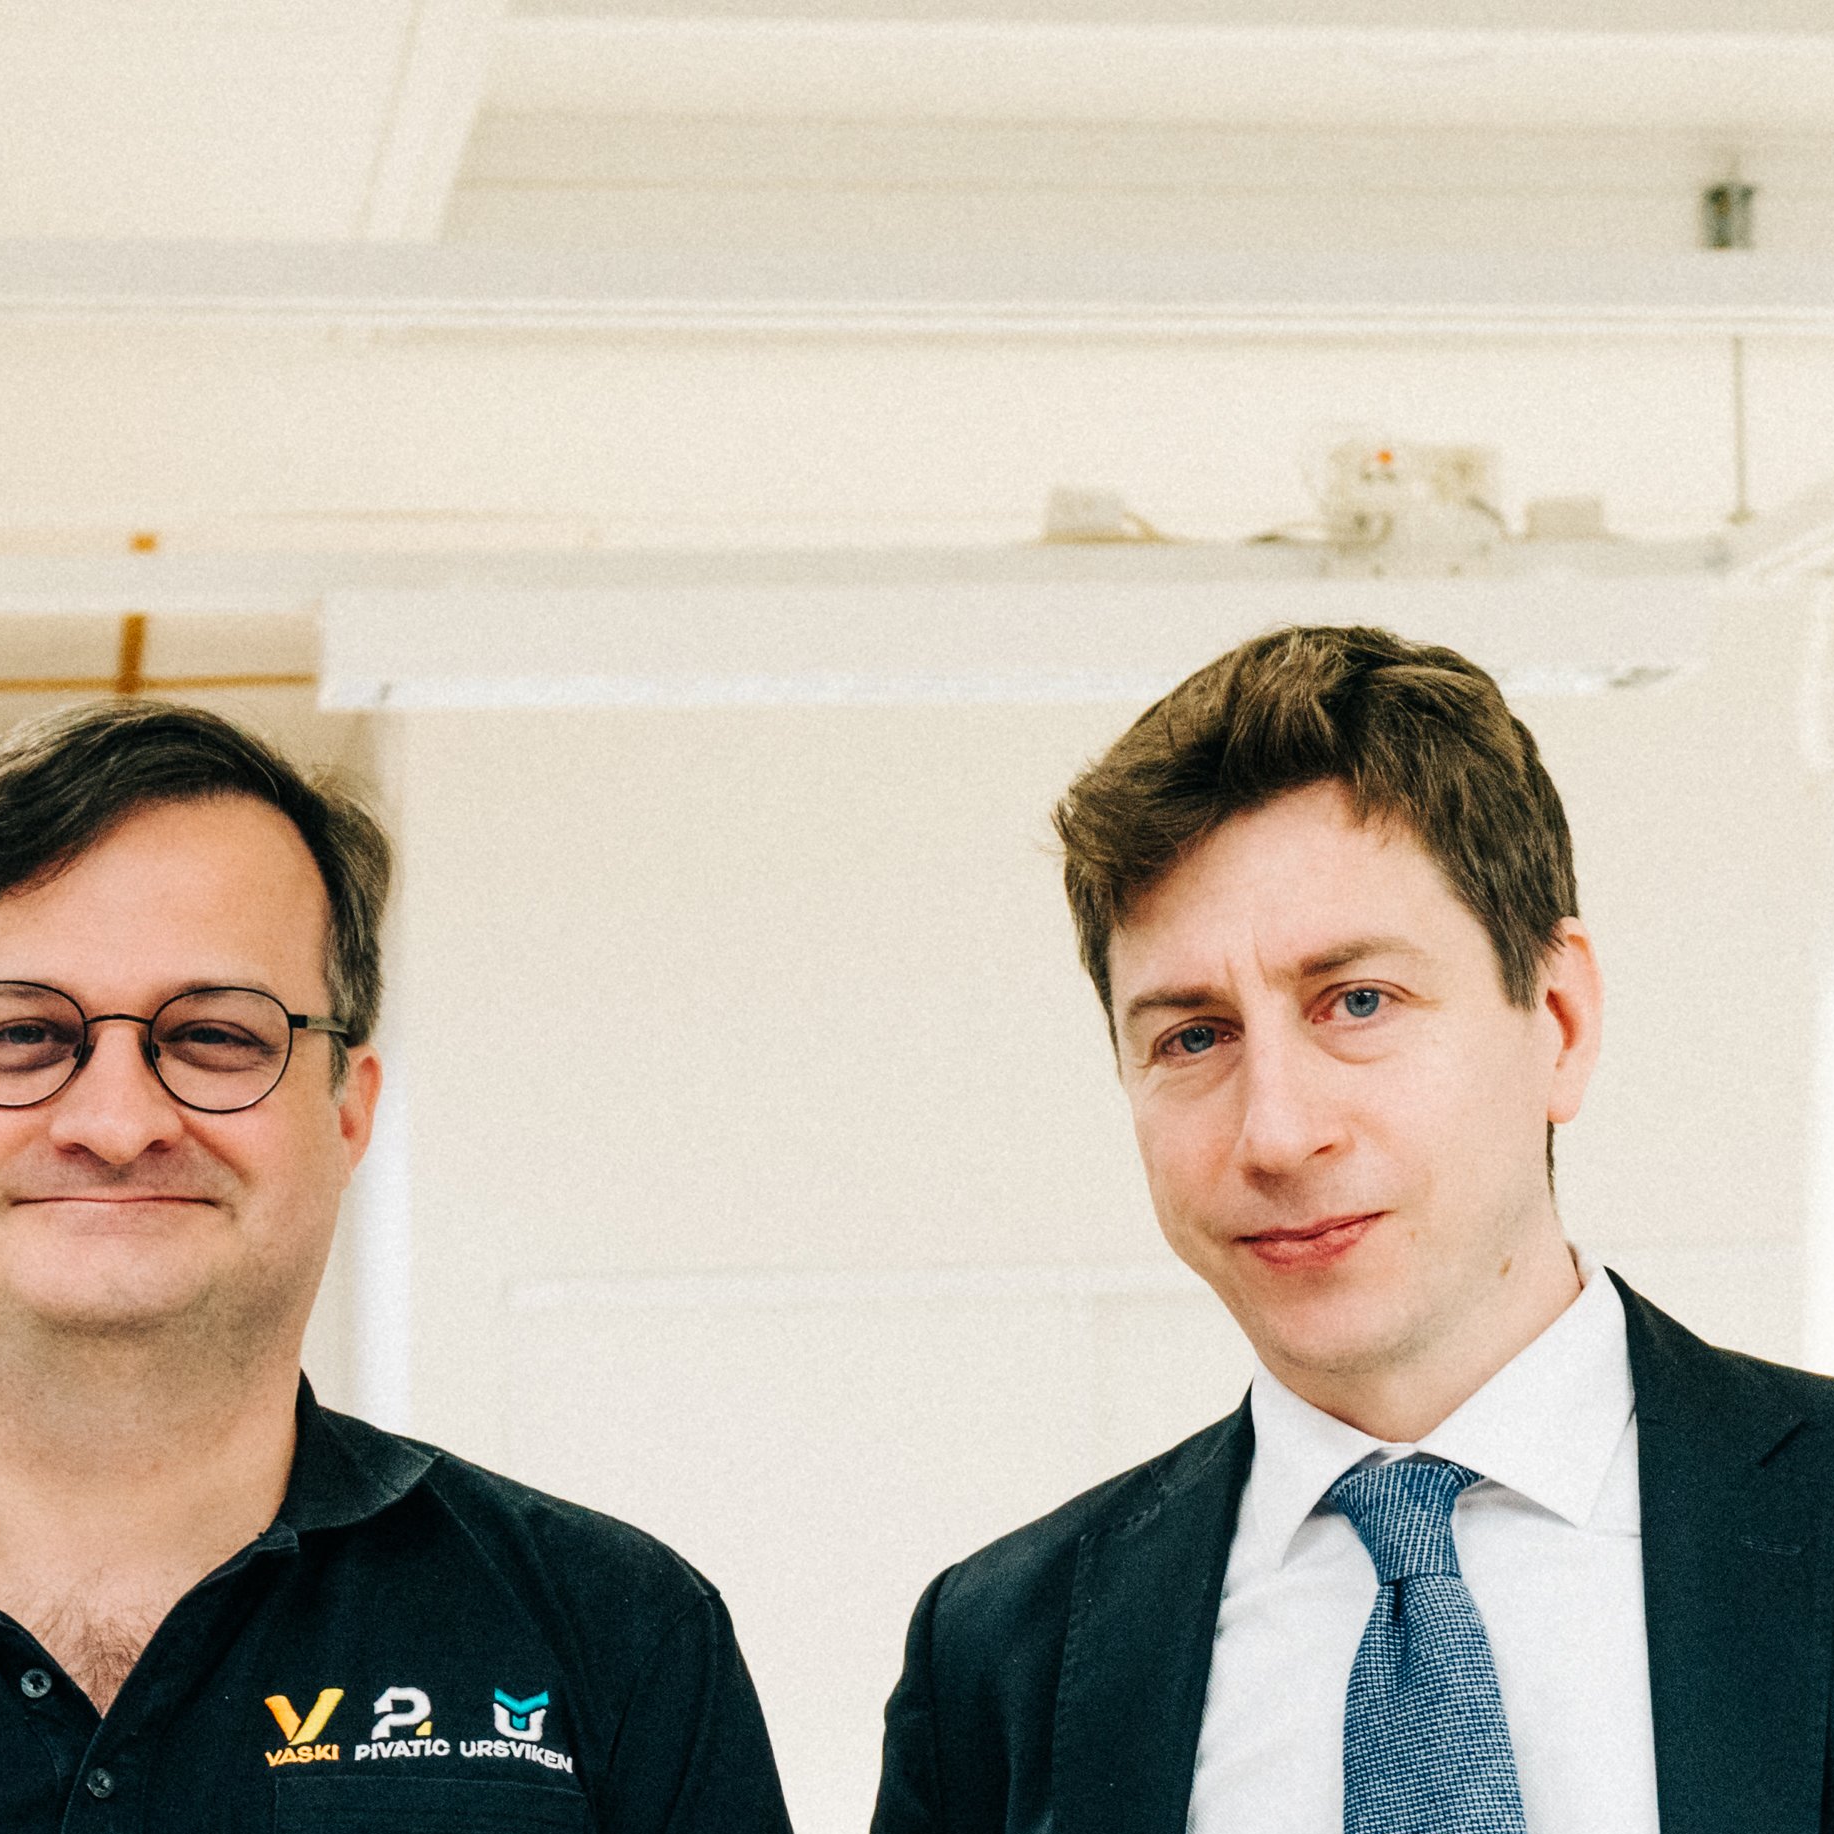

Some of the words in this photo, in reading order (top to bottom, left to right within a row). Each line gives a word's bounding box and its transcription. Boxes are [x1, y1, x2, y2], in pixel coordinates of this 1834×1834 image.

[264, 1744, 340, 1767] VASKI
[354, 1738, 451, 1761] PIVATIC
[459, 1739, 573, 1773] URSVIKEN
